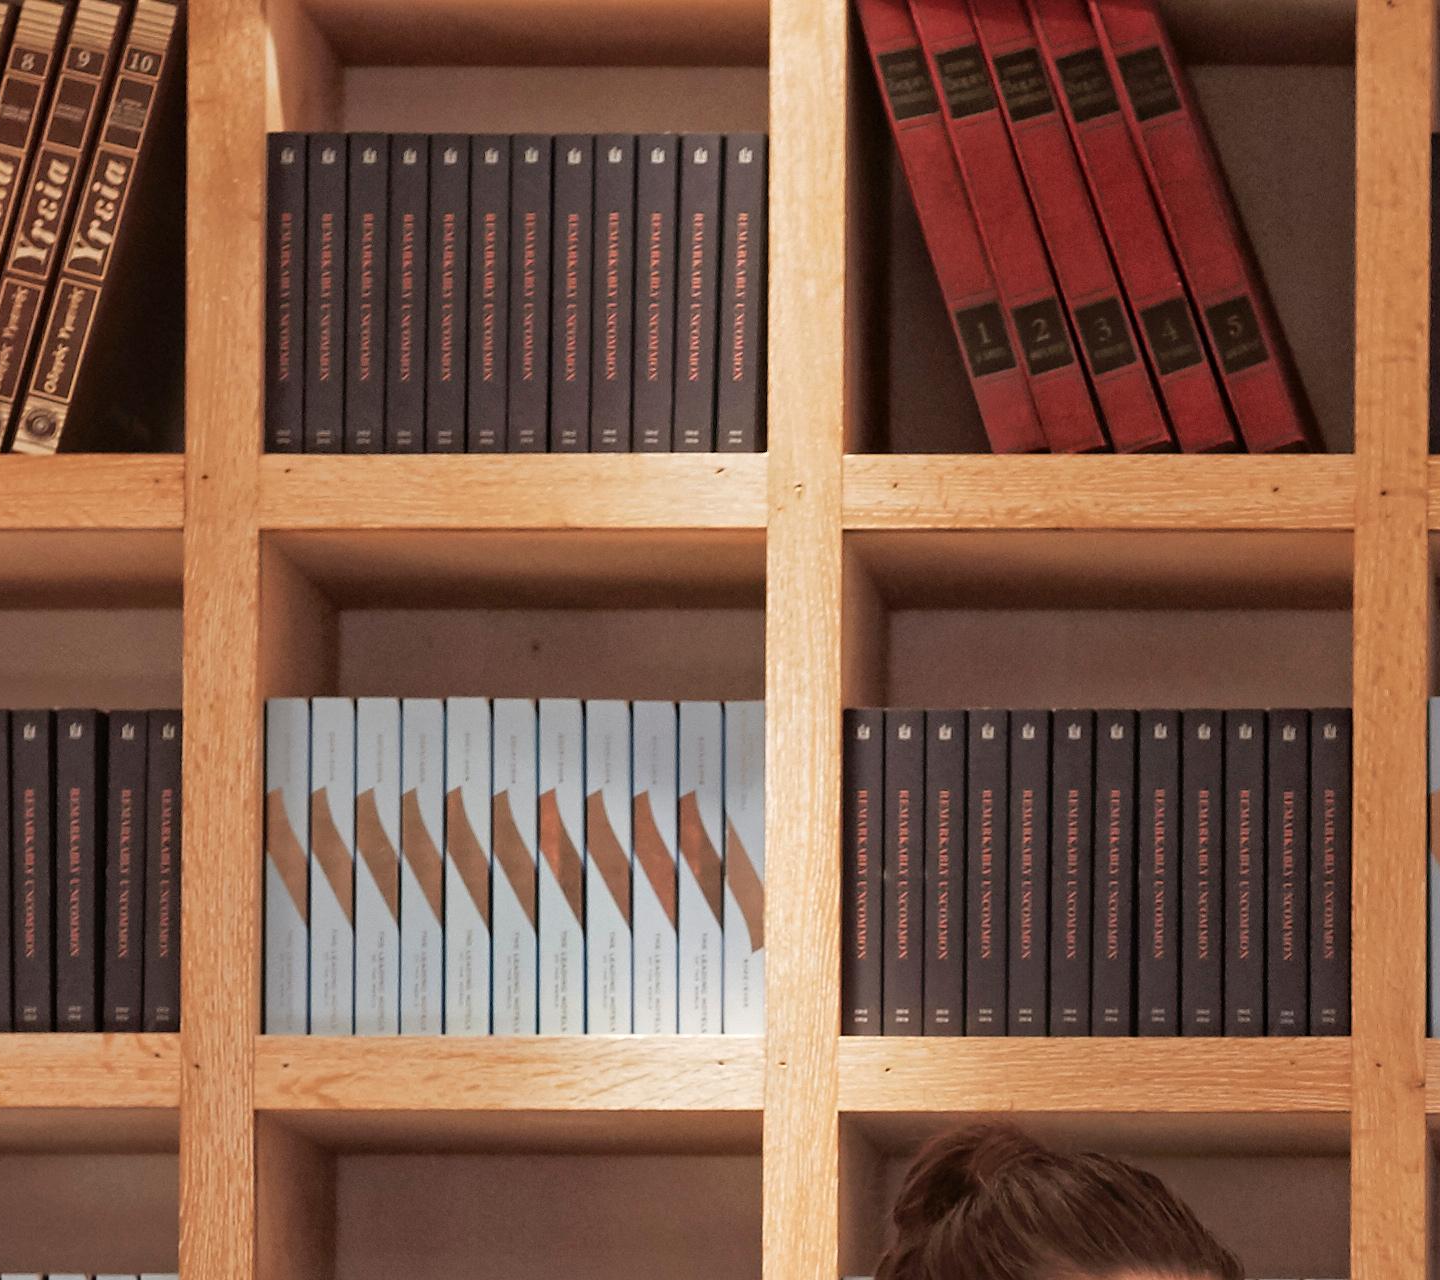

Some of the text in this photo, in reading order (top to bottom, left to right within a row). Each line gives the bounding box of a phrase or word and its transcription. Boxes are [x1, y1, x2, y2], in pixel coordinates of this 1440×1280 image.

[21, 54, 35, 70] 8
[130, 53, 152, 70] 10
[1031, 319, 1050, 341] 2
[1096, 318, 1112, 341] 3
